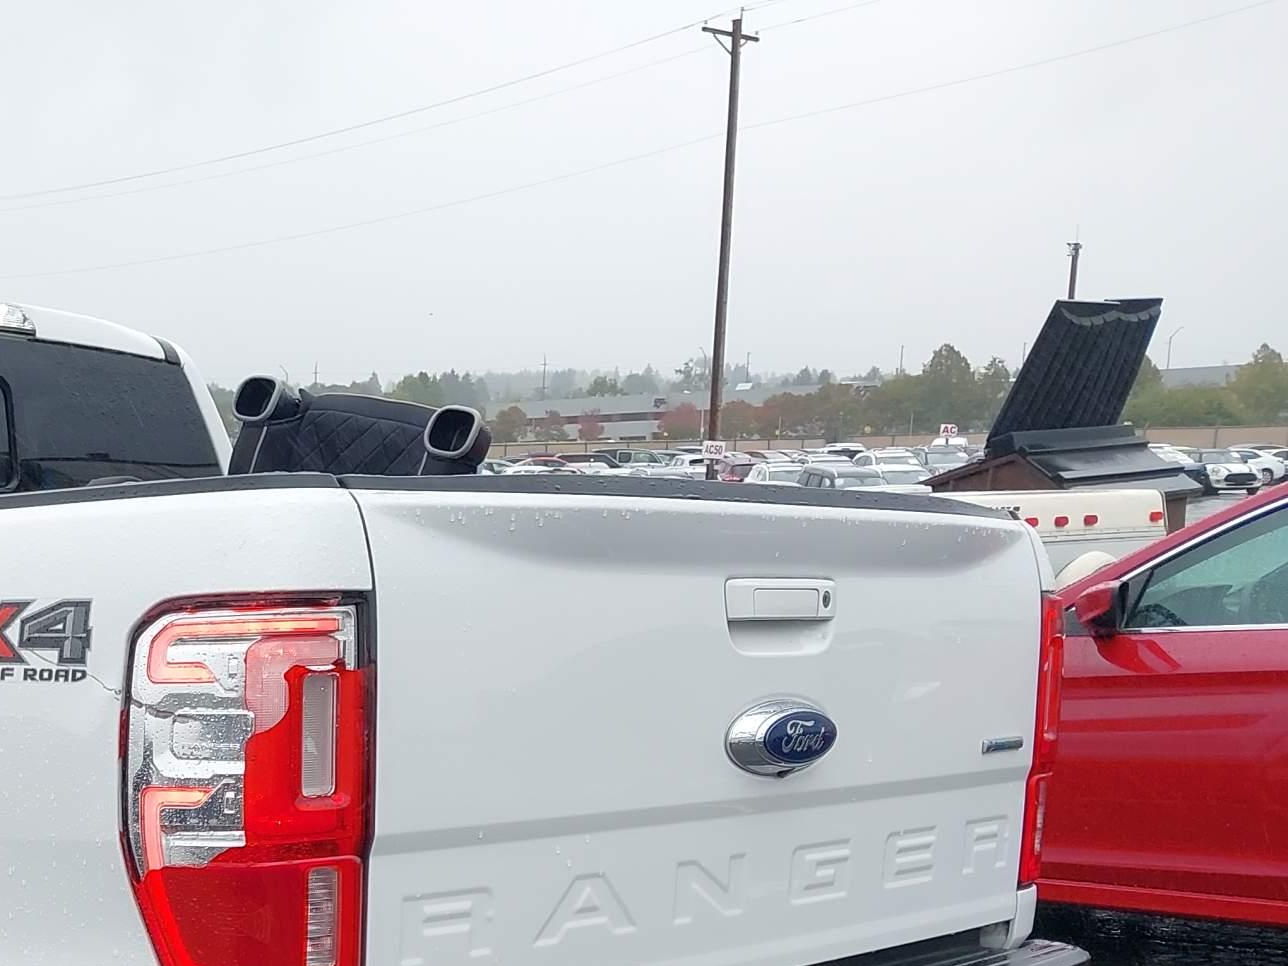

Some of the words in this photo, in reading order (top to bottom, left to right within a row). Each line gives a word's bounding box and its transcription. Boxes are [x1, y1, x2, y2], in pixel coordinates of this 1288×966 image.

[942, 425, 958, 434] AC
[23, 668, 87, 682] ROAD
[782, 720, 825, 753] Ford
[400, 815, 1009, 966] RANGER
